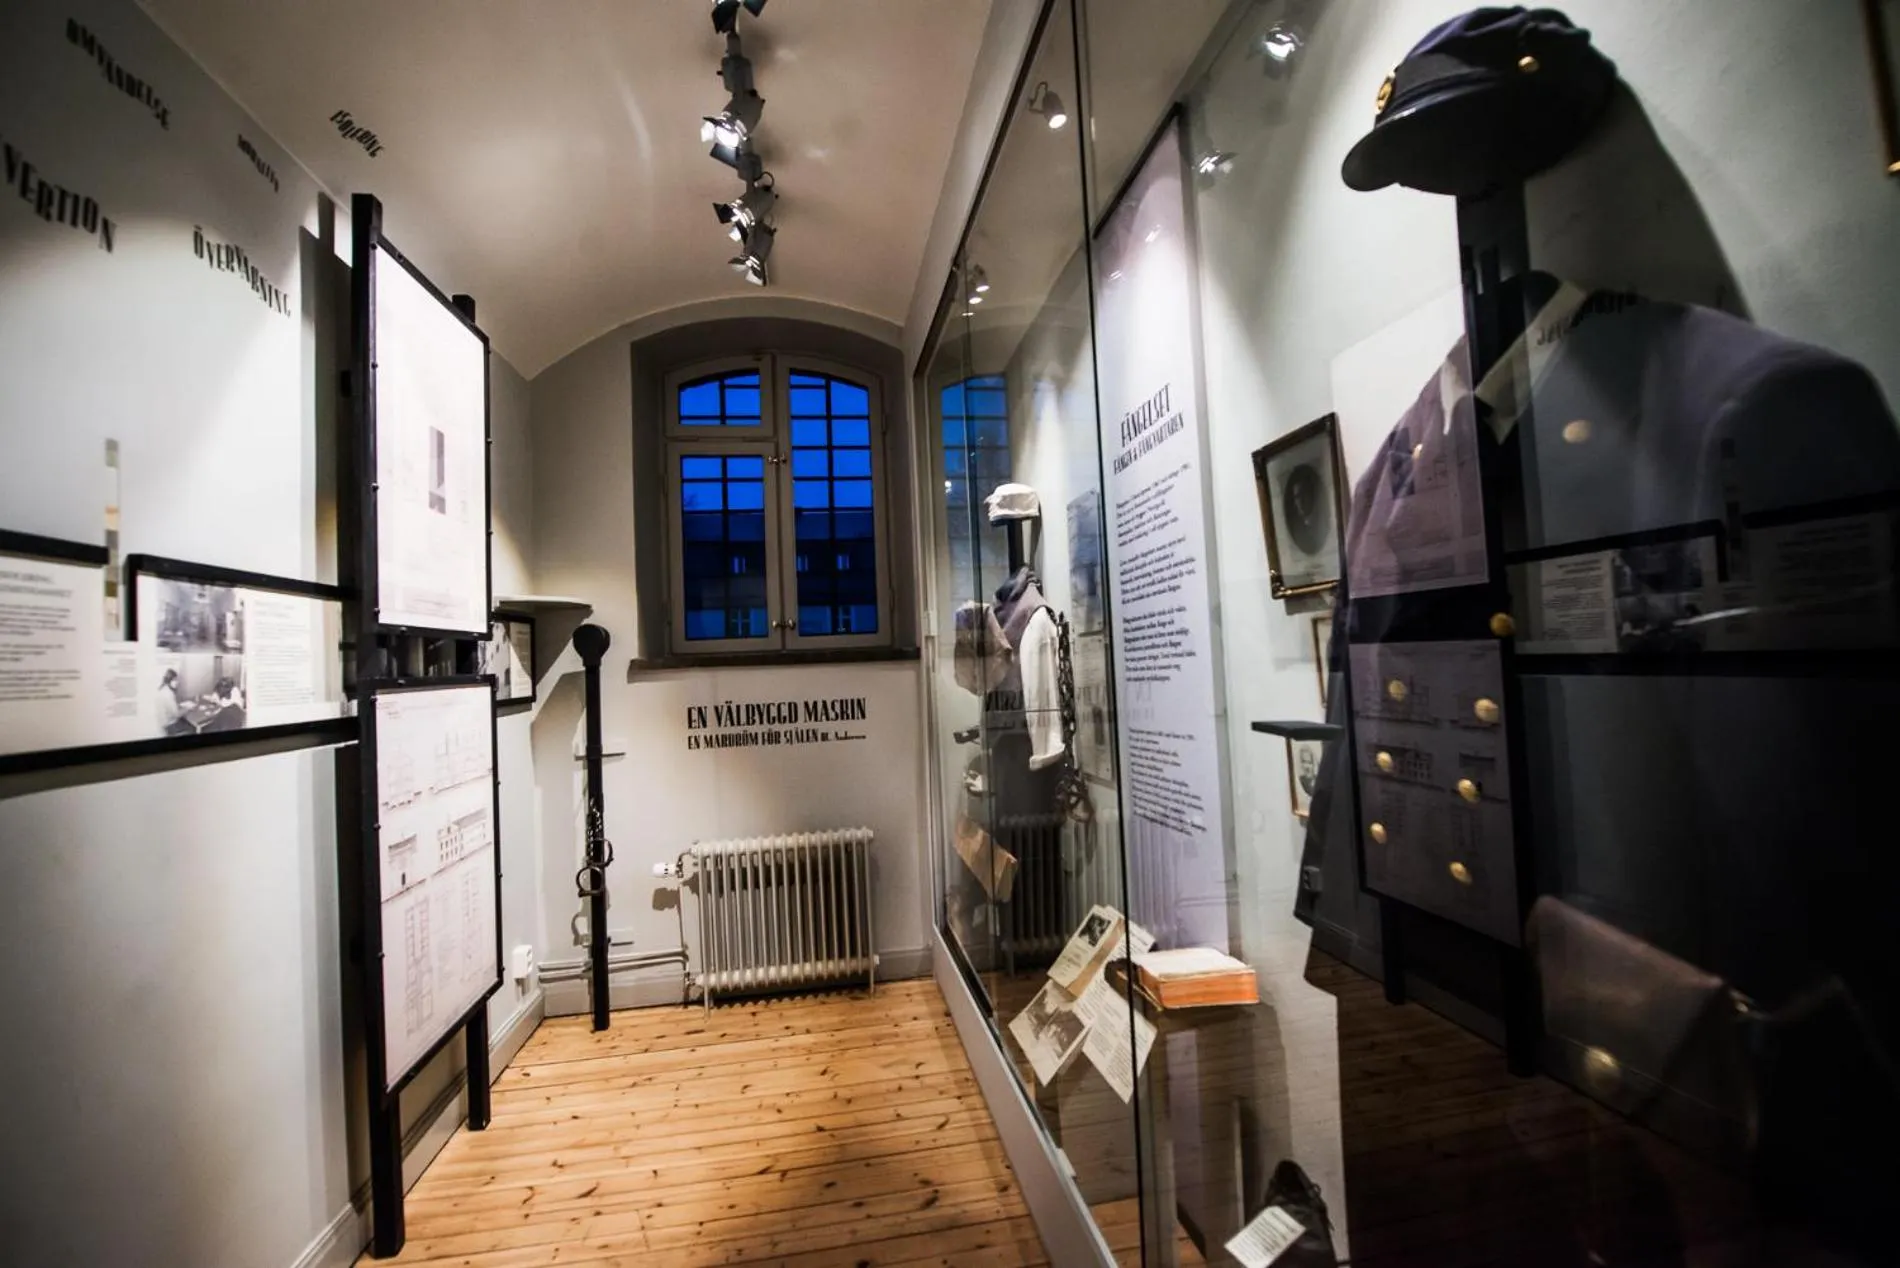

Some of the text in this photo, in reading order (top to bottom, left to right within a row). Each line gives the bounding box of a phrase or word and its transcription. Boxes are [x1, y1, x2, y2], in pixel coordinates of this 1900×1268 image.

[687, 697, 867, 729] EN VÄLBYGGD MASKIN
[687, 735, 702, 750] EN
[761, 728, 782, 746] FÖR
